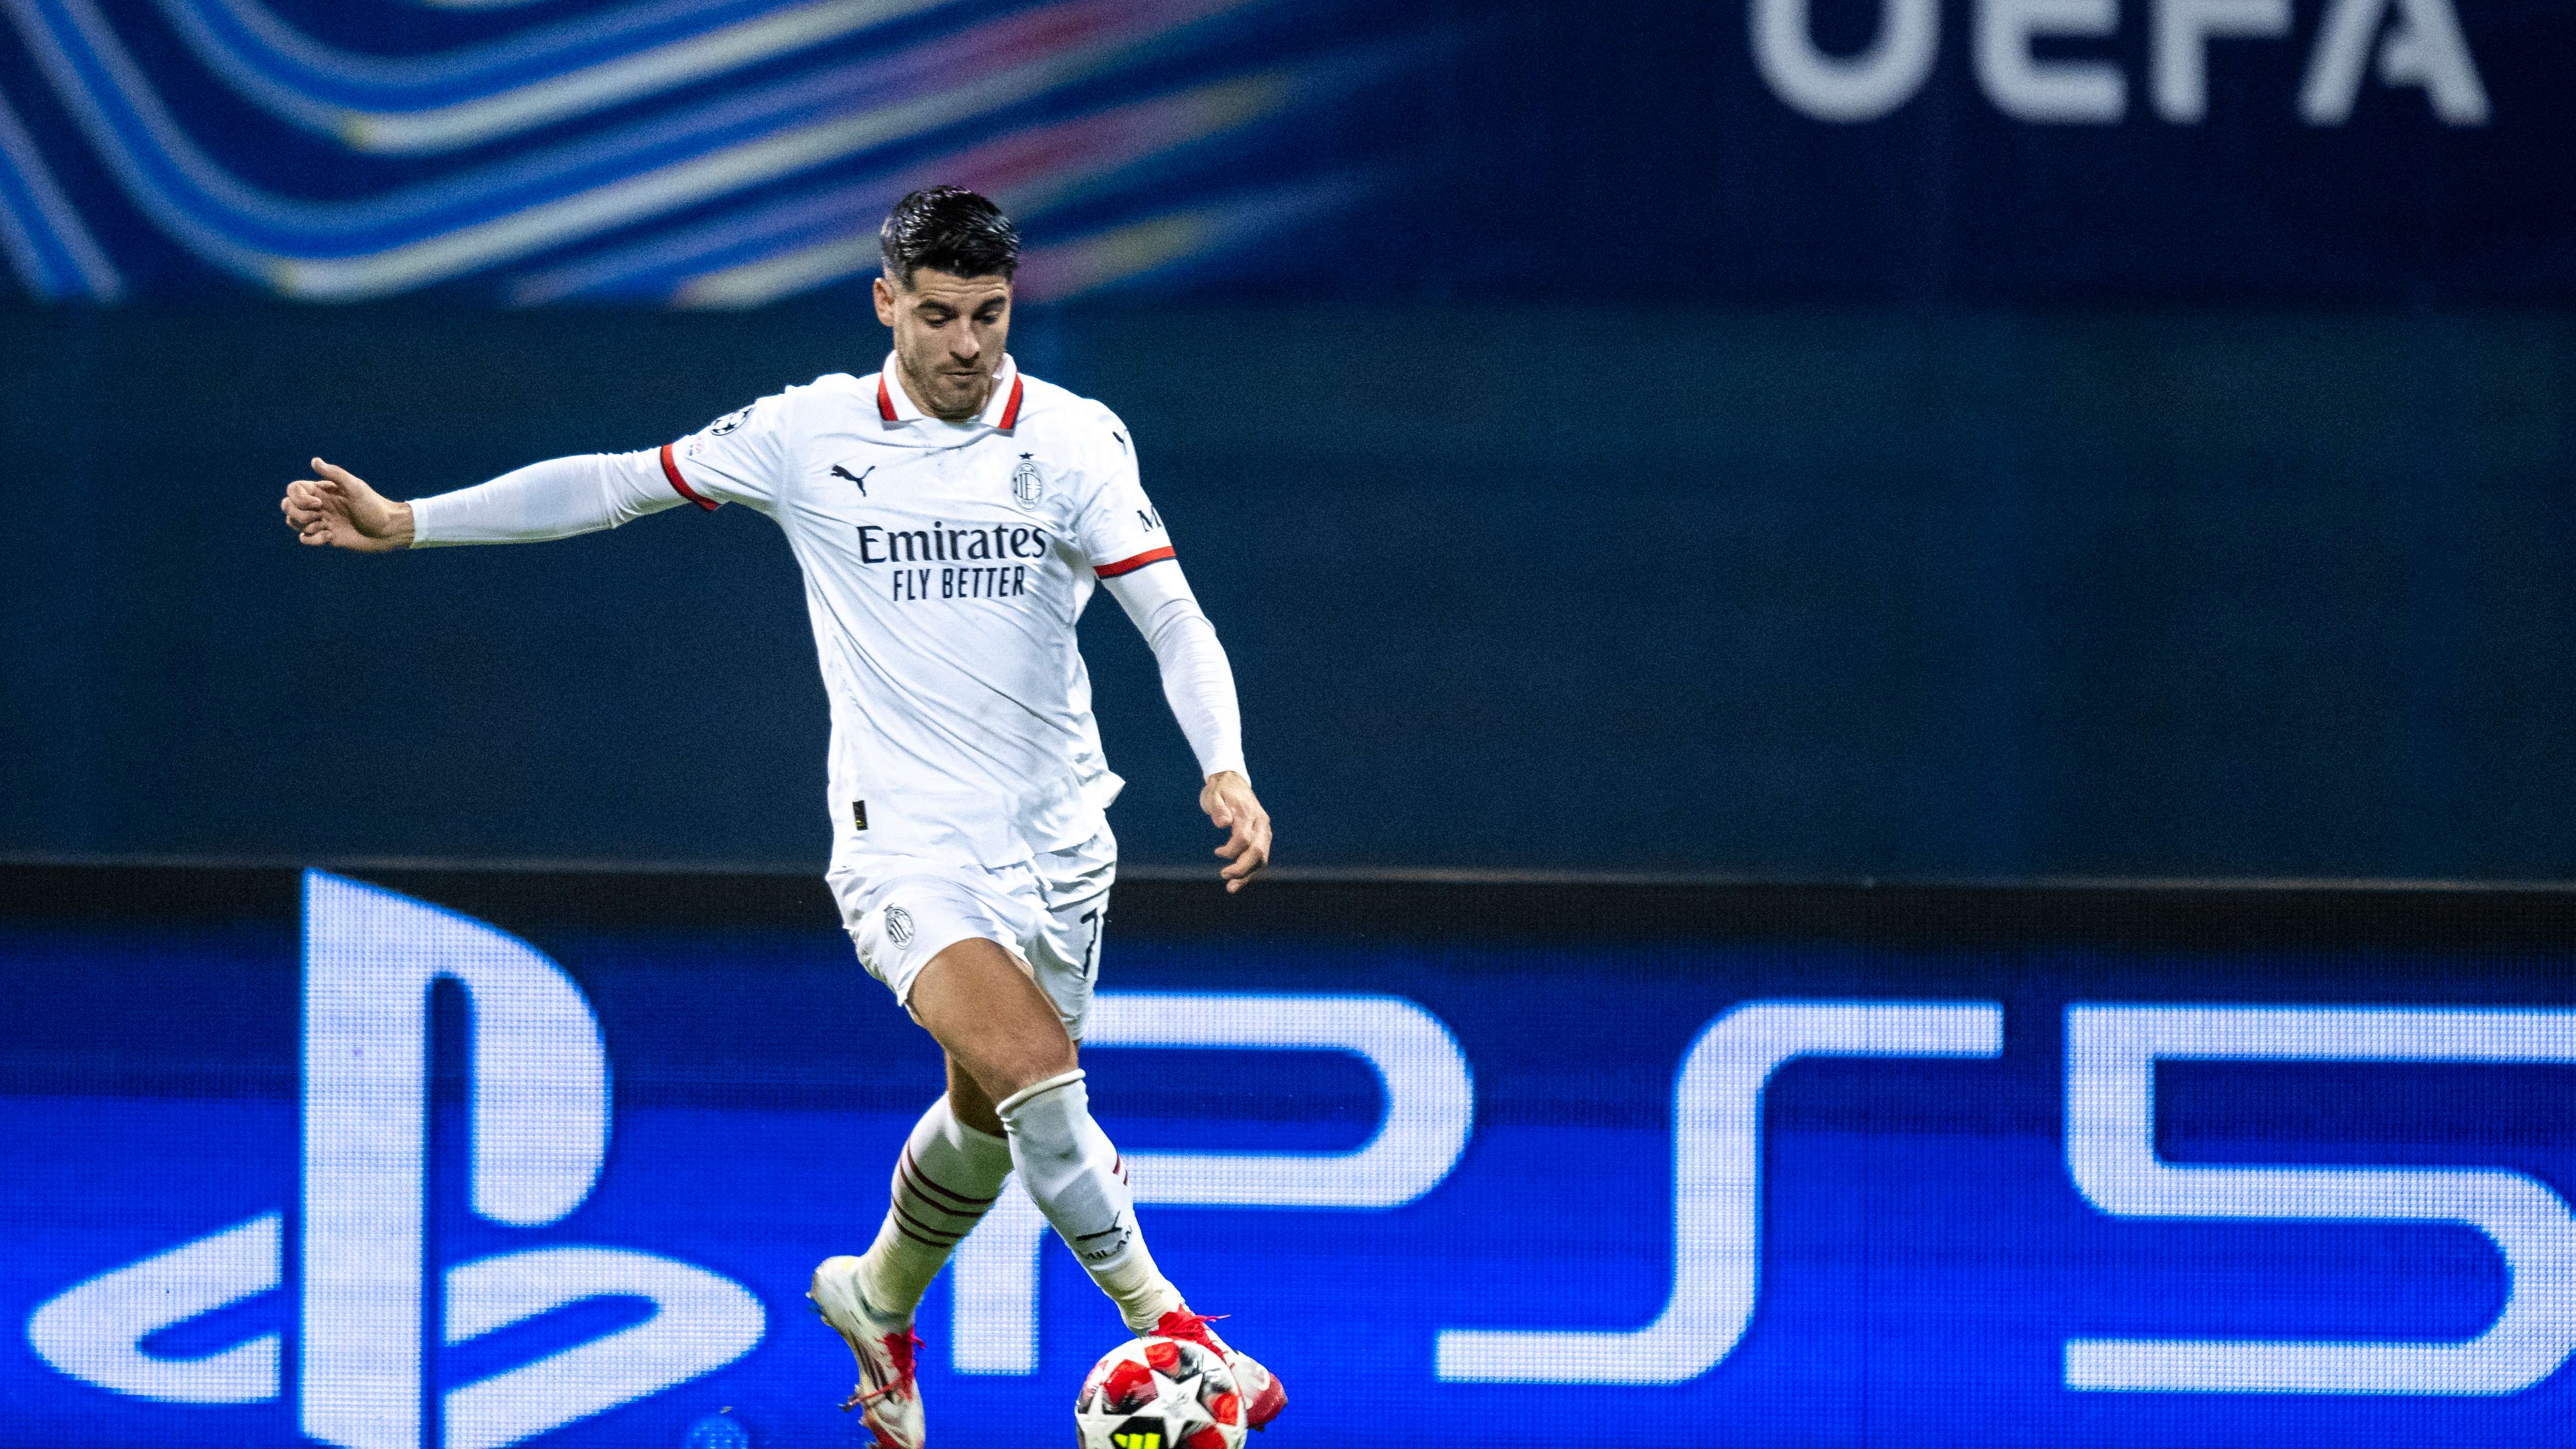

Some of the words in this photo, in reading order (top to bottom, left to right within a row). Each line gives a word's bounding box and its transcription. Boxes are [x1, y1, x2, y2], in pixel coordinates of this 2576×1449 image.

[857, 521, 1047, 564] Emirates
[893, 569, 931, 602] FLY
[942, 566, 1025, 599] BETTER
[1080, 907, 1098, 978] 7
[952, 995, 2576, 1397] PS5
